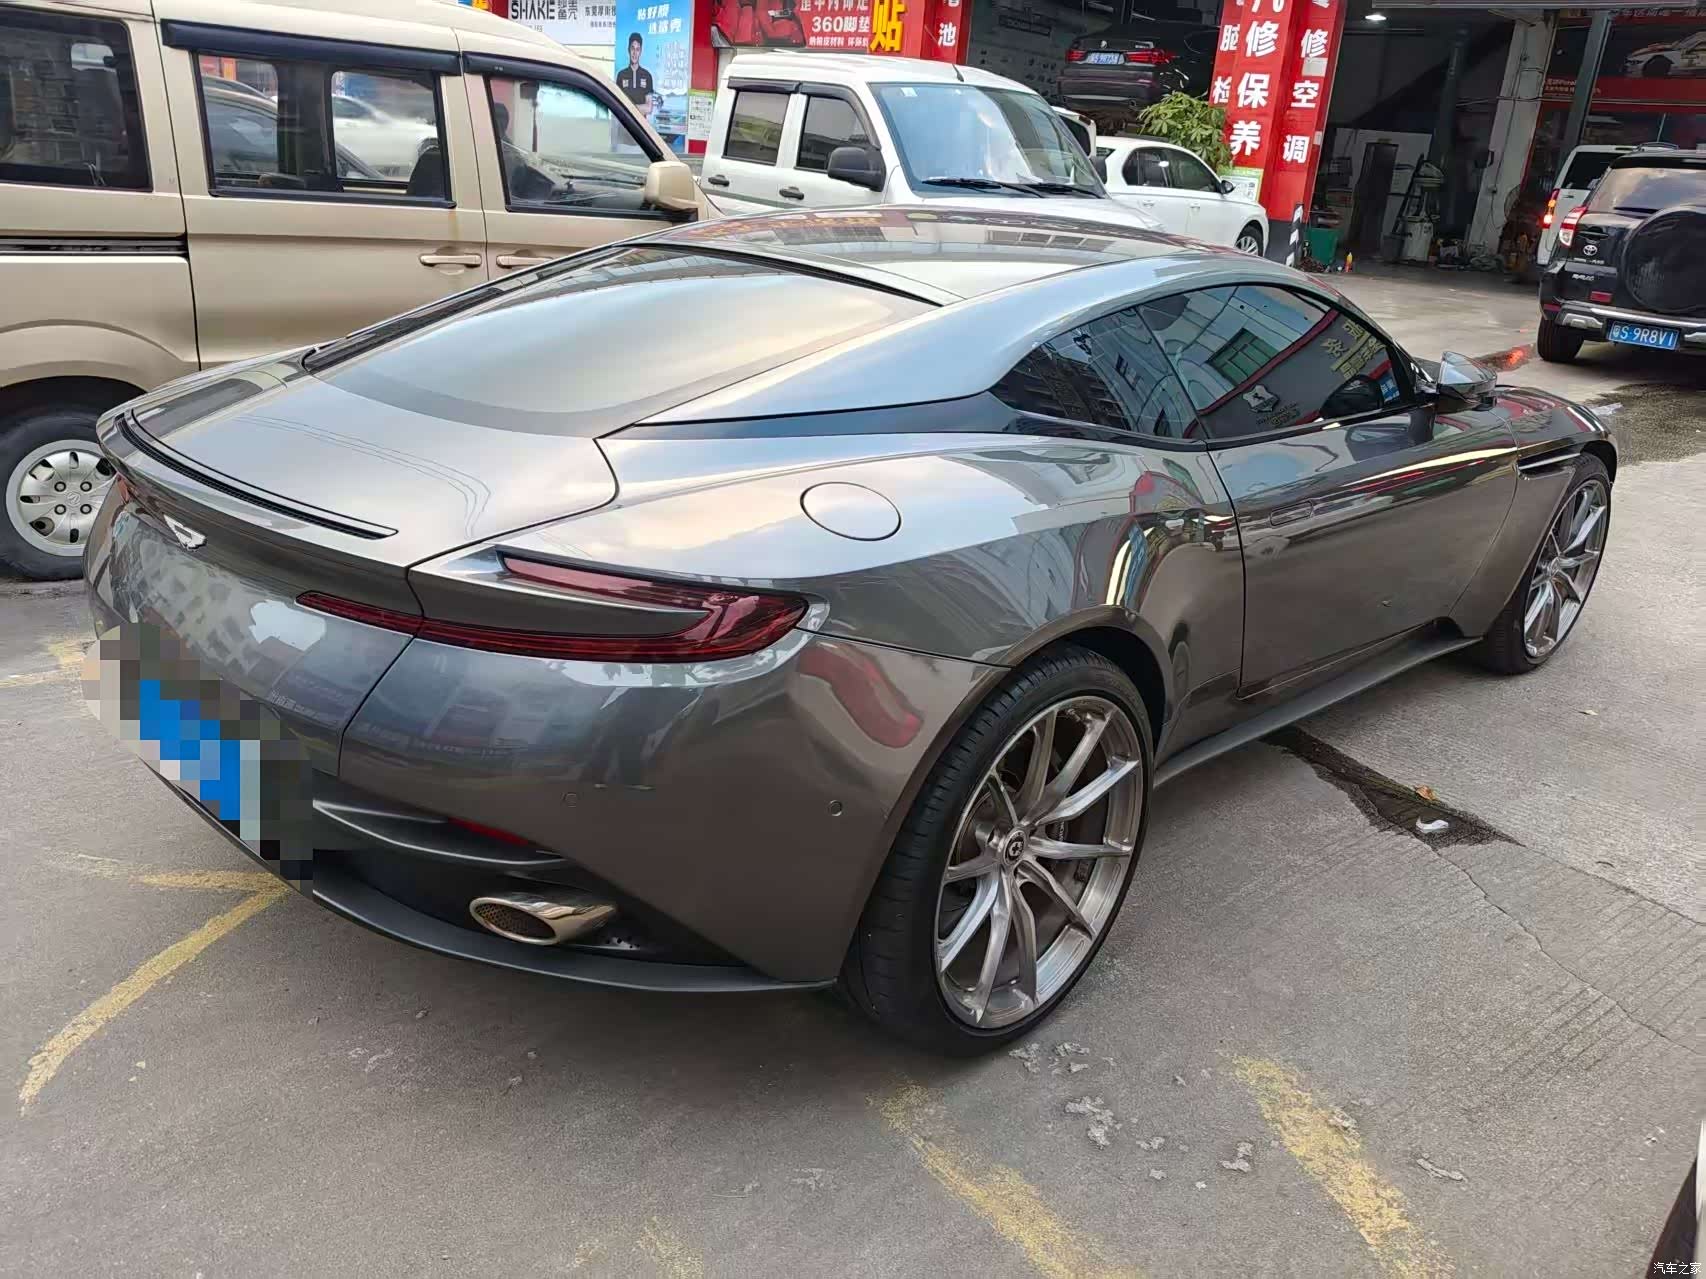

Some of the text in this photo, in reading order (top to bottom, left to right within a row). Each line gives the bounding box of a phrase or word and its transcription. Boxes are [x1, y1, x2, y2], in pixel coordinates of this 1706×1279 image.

[511, 0, 555, 20] SHAKE
[811, 16, 871, 33] 360脚垫
[869, 0, 906, 52] 贴
